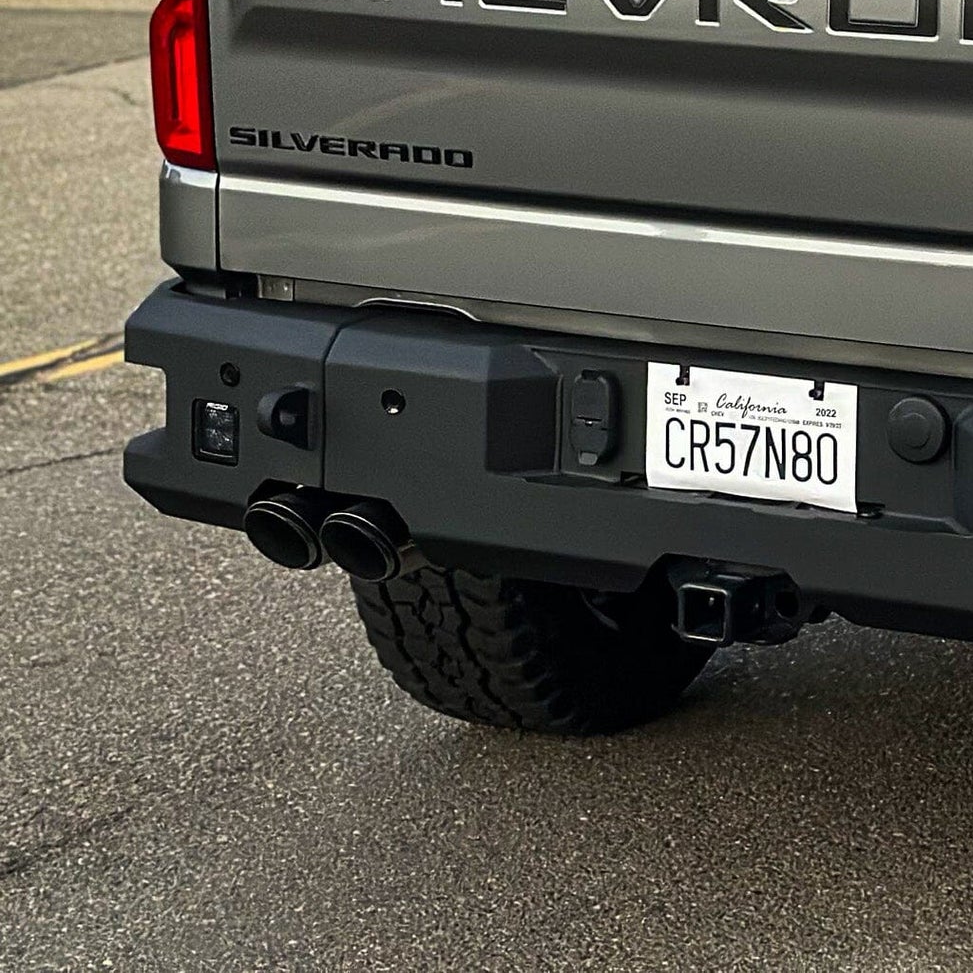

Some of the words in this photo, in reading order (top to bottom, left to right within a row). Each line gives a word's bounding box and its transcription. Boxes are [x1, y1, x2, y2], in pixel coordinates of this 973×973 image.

[229, 126, 474, 169] SILVERADO
[664, 391, 687, 406] SEP
[715, 392, 788, 418] California
[815, 407, 837, 418] 2022
[665, 416, 838, 485] CR57N80
